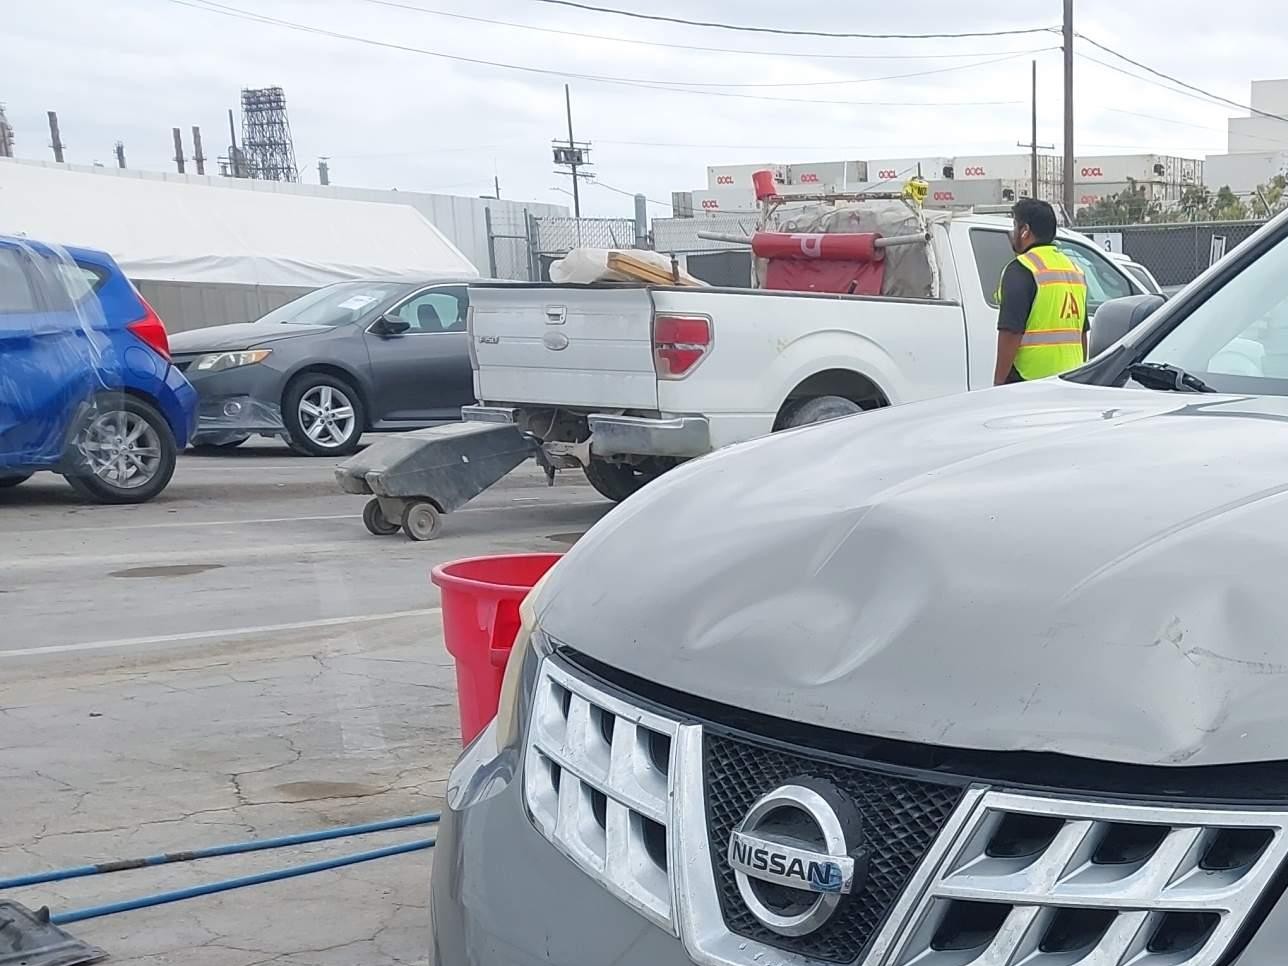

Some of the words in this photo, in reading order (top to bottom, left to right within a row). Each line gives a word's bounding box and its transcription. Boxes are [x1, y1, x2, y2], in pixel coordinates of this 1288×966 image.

[879, 170, 897, 179] OOCL
[965, 167, 985, 176] OOCL
[1081, 167, 1103, 177] OOCL
[717, 176, 734, 185] OOCL
[801, 174, 819, 183] OOCL
[934, 192, 954, 201] OOCL
[702, 200, 719, 209] OOCL
[1104, 239, 1112, 253] 3
[732, 840, 832, 885] NISSAN
